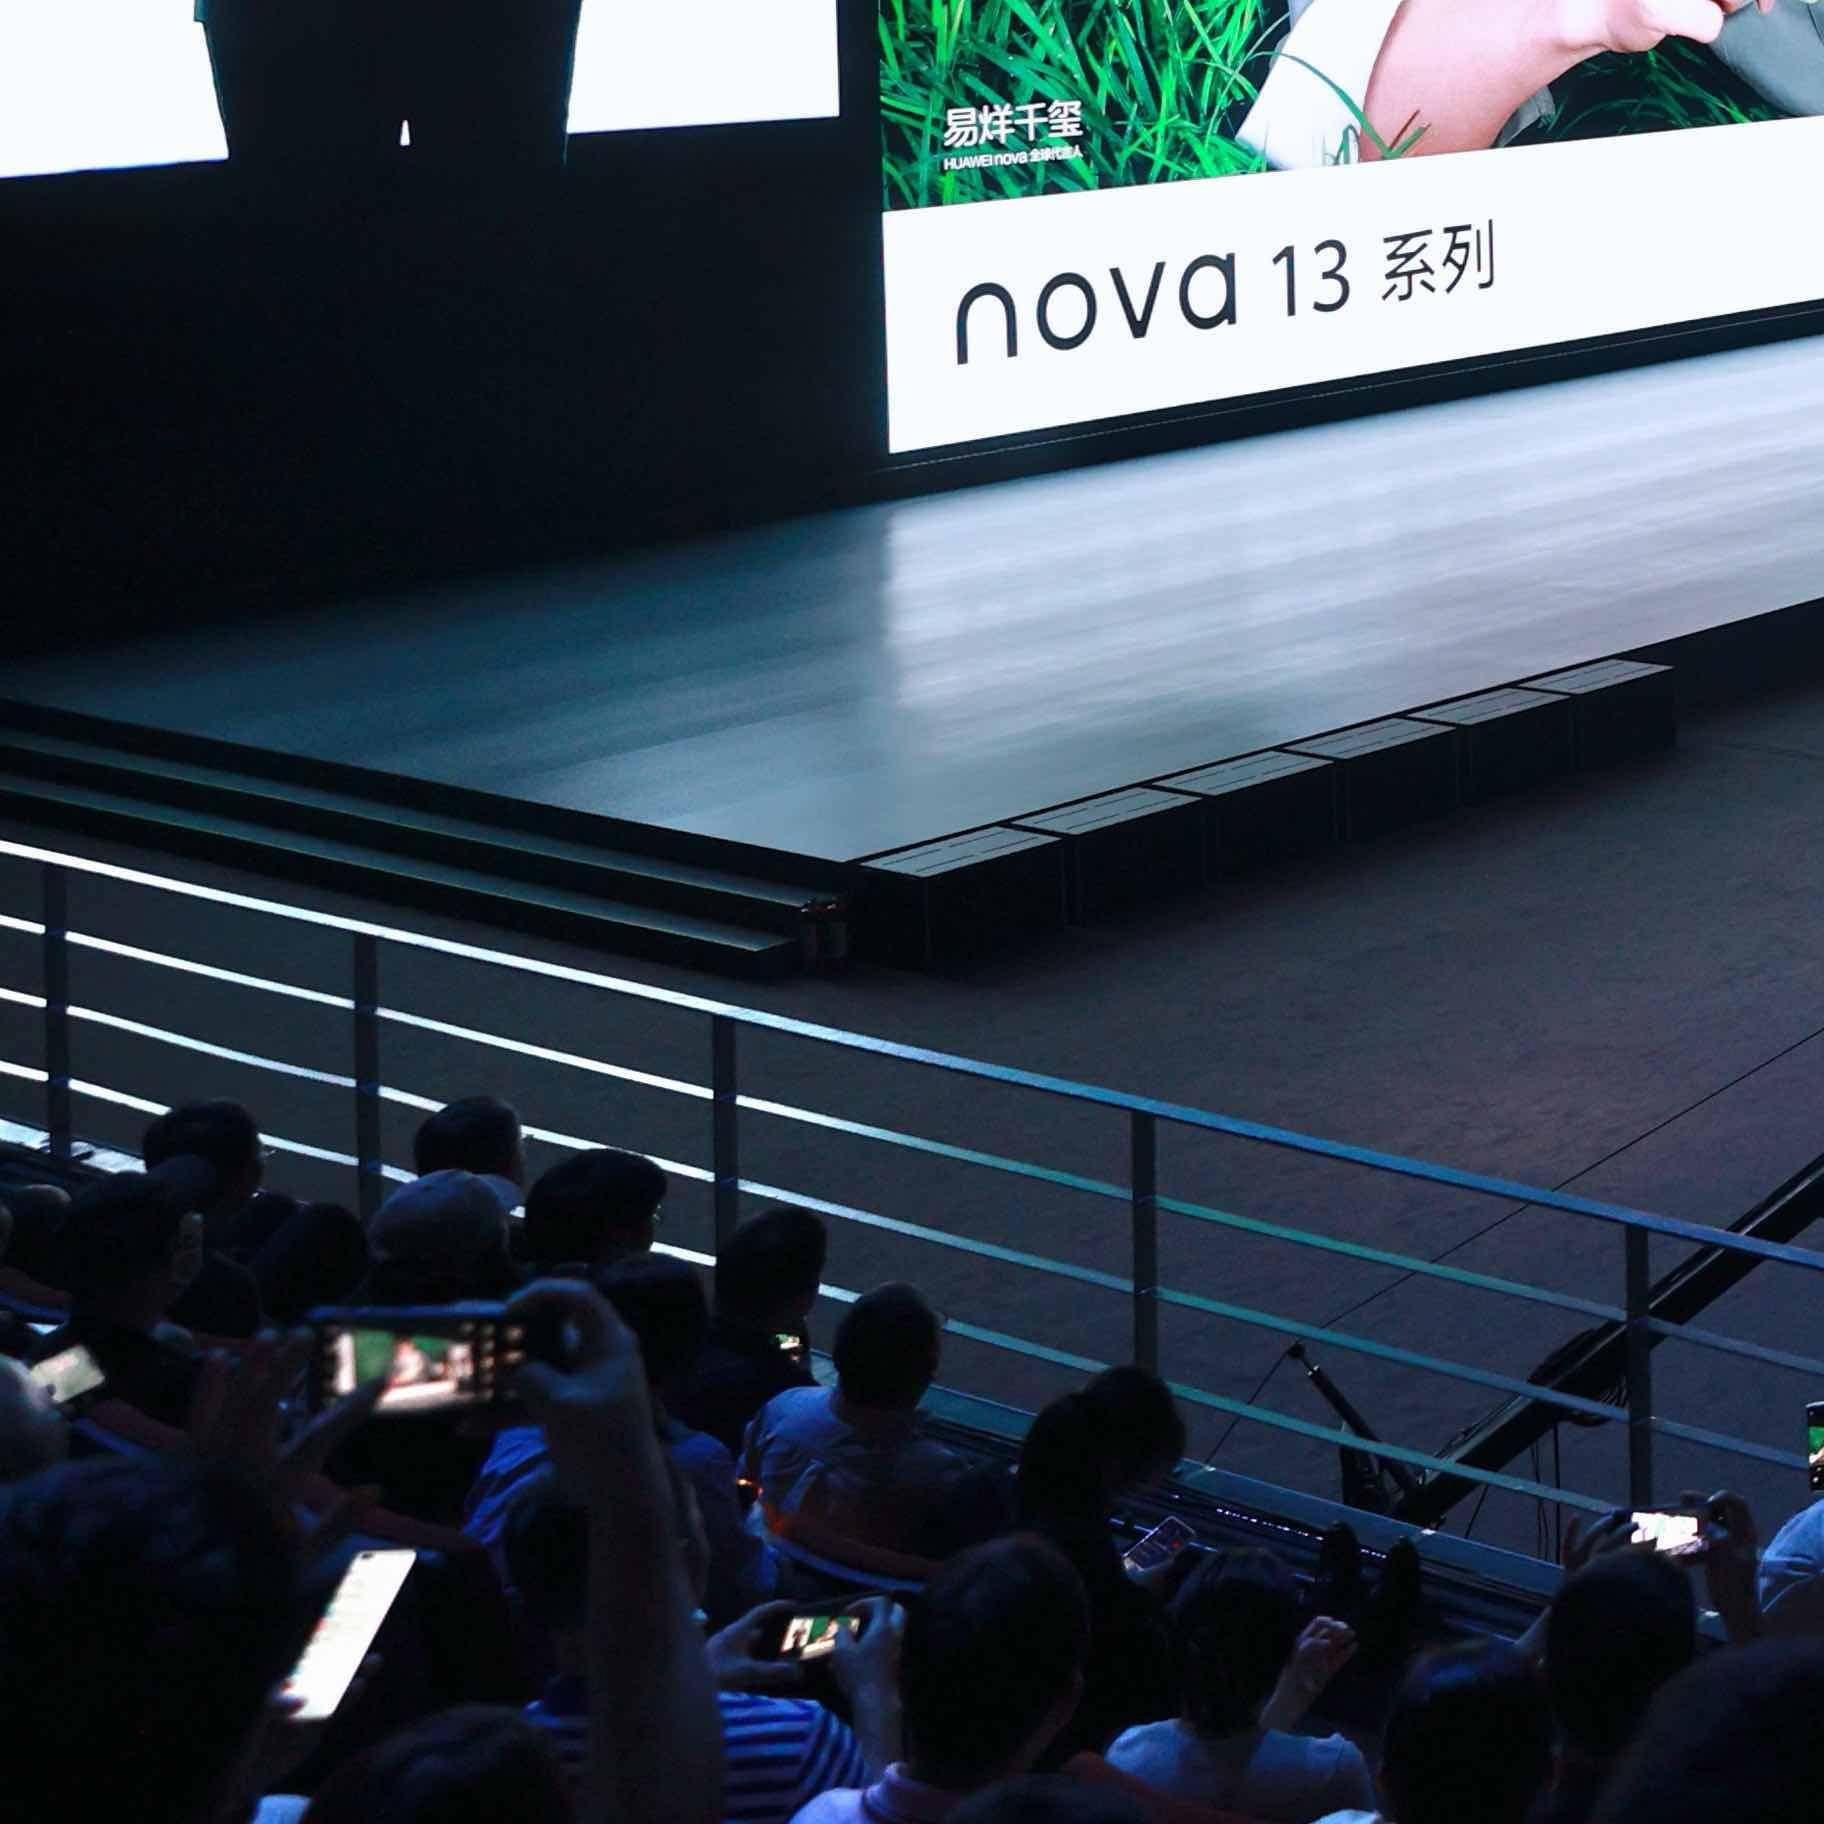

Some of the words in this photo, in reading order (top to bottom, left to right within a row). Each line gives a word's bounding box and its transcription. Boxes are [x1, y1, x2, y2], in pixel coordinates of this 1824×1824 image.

[943, 99, 1084, 148] 易烊千玺
[943, 152, 993, 171] HUAWEI
[995, 150, 1028, 166] nova
[956, 252, 1236, 366] nova
[1271, 238, 1351, 318] 13
[1380, 218, 1495, 303] 系列
